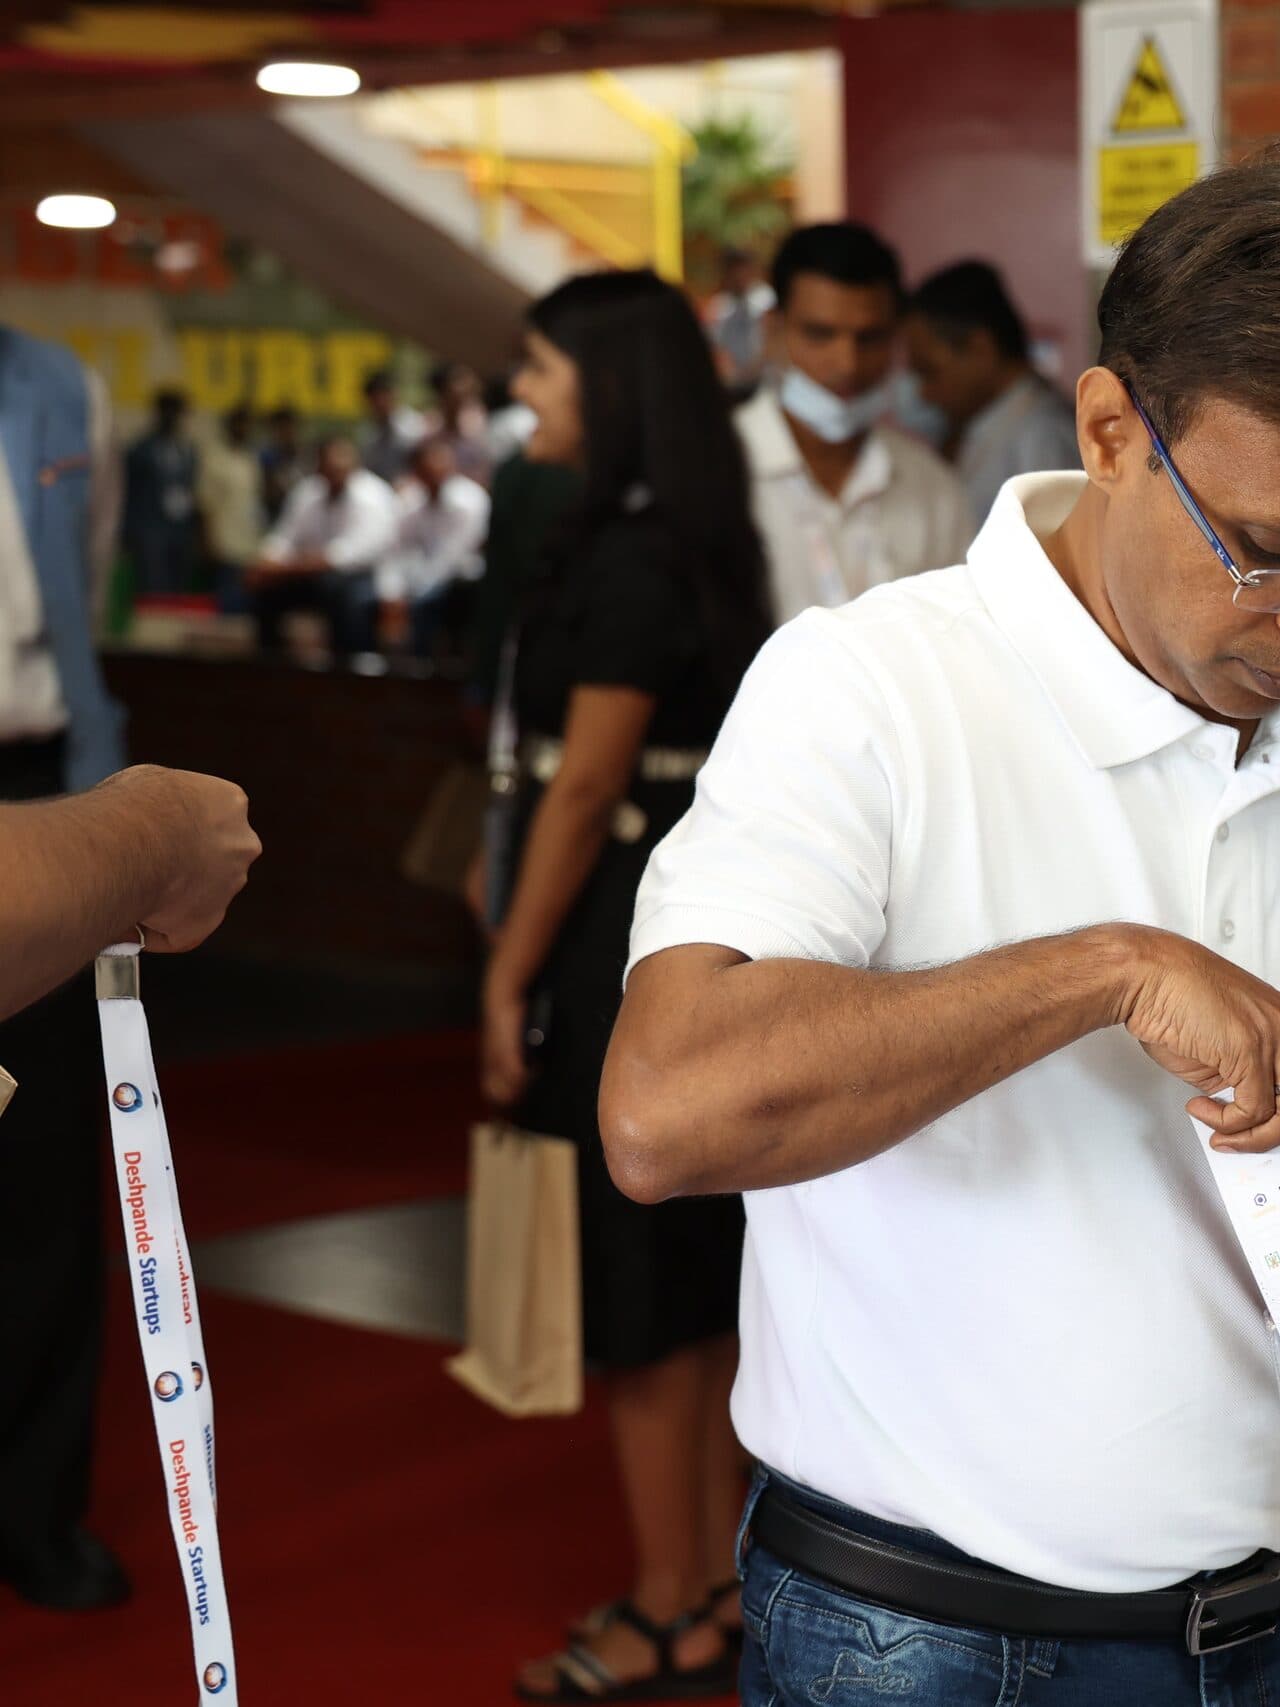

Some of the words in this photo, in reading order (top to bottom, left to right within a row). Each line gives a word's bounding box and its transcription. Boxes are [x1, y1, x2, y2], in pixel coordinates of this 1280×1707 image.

[124, 1151, 150, 1254] Deshpande
[139, 1257, 161, 1336] Startups
[169, 1439, 197, 1544] Deshpande
[188, 1546, 209, 1627] Startups
